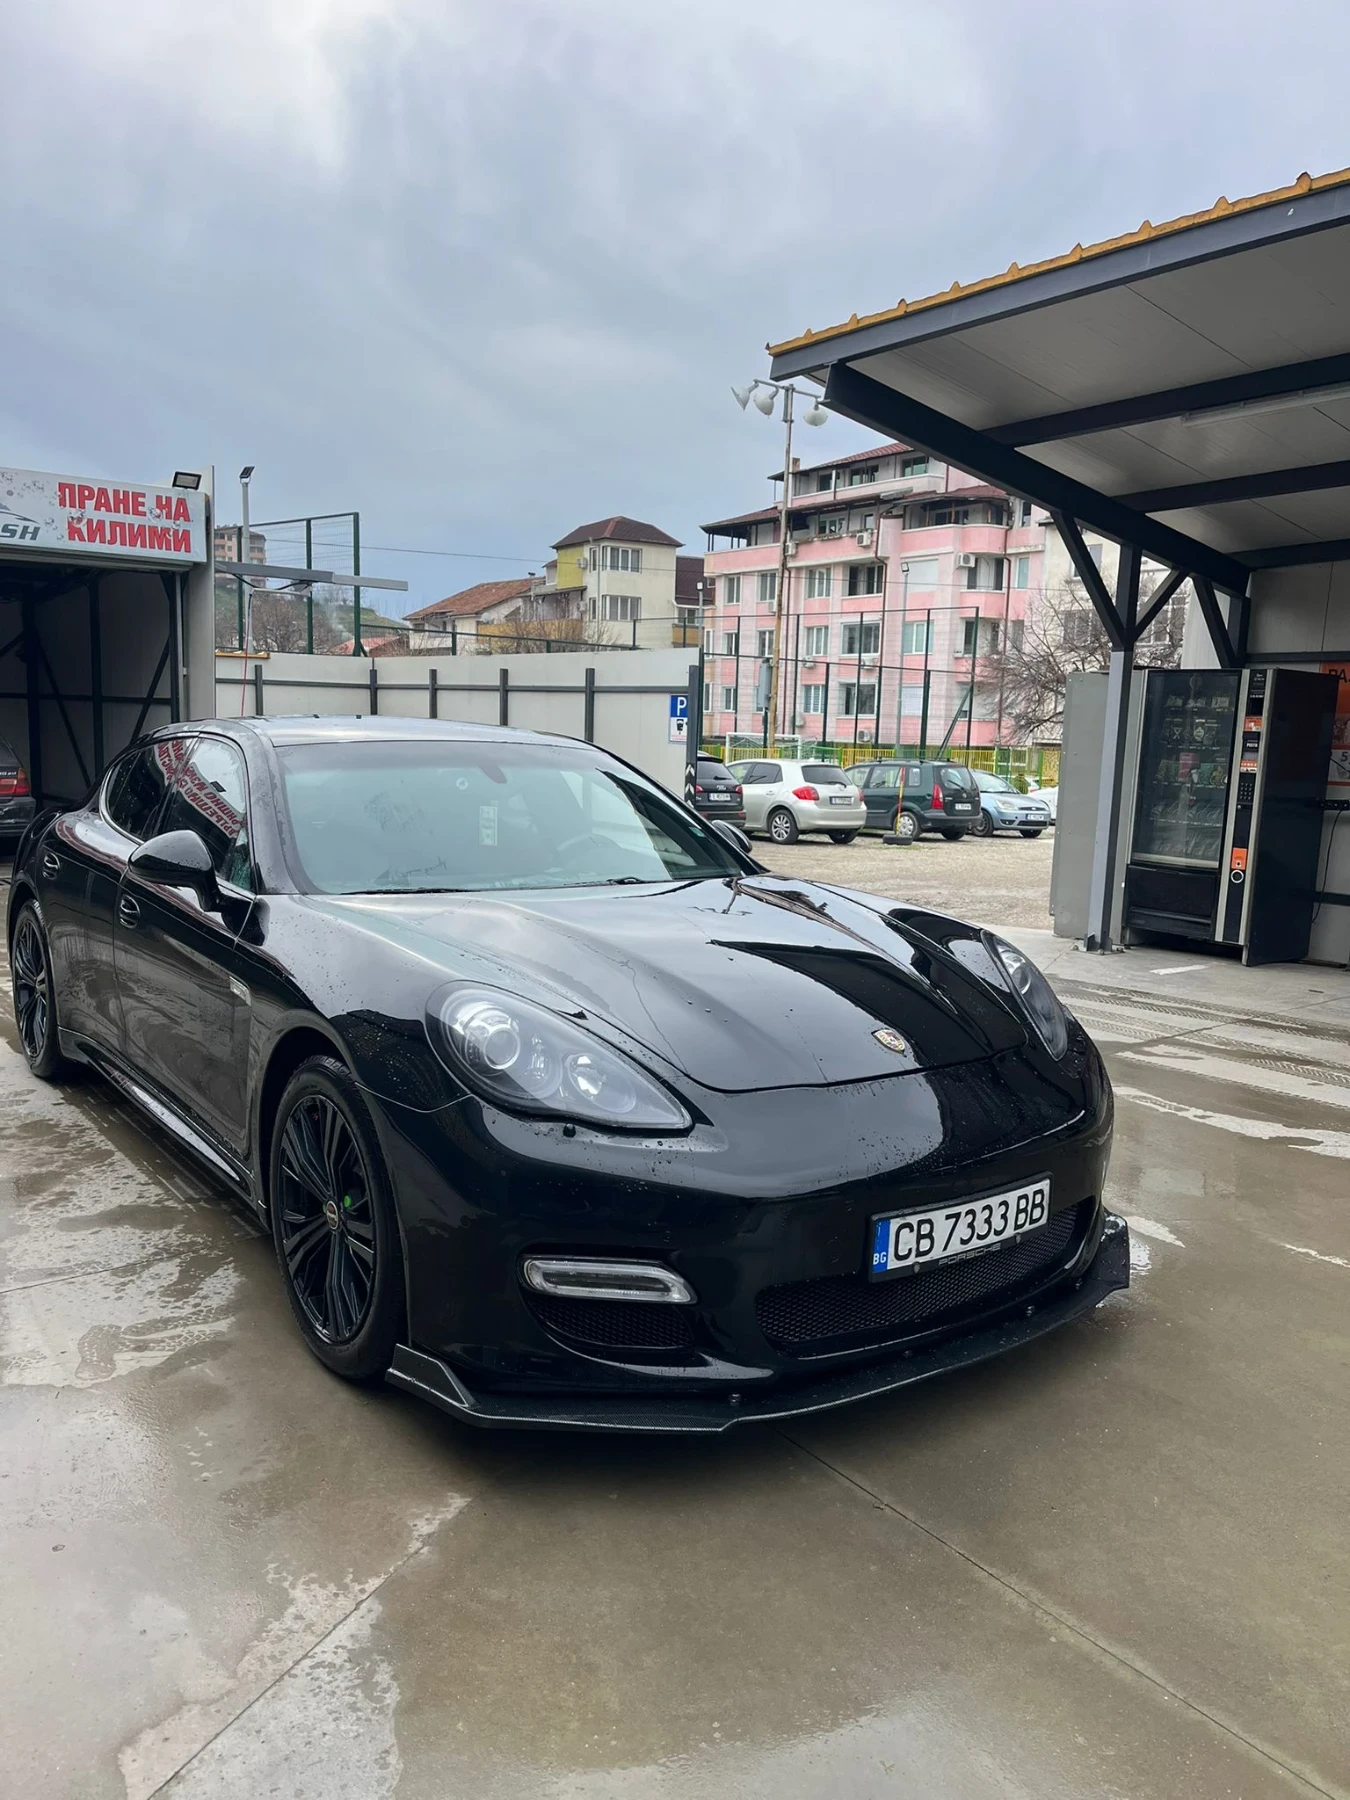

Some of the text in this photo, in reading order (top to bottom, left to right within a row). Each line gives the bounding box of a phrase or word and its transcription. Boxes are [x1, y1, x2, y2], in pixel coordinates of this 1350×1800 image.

[58, 482, 191, 522] ПРАНЕ НА
[67, 516, 191, 553] КИЛИМИ
[677, 696, 687, 716] P
[894, 1188, 1045, 1261] CB 7333 BB
[873, 1253, 886, 1265] BG
[938, 1244, 1001, 1266] PORSCHE
